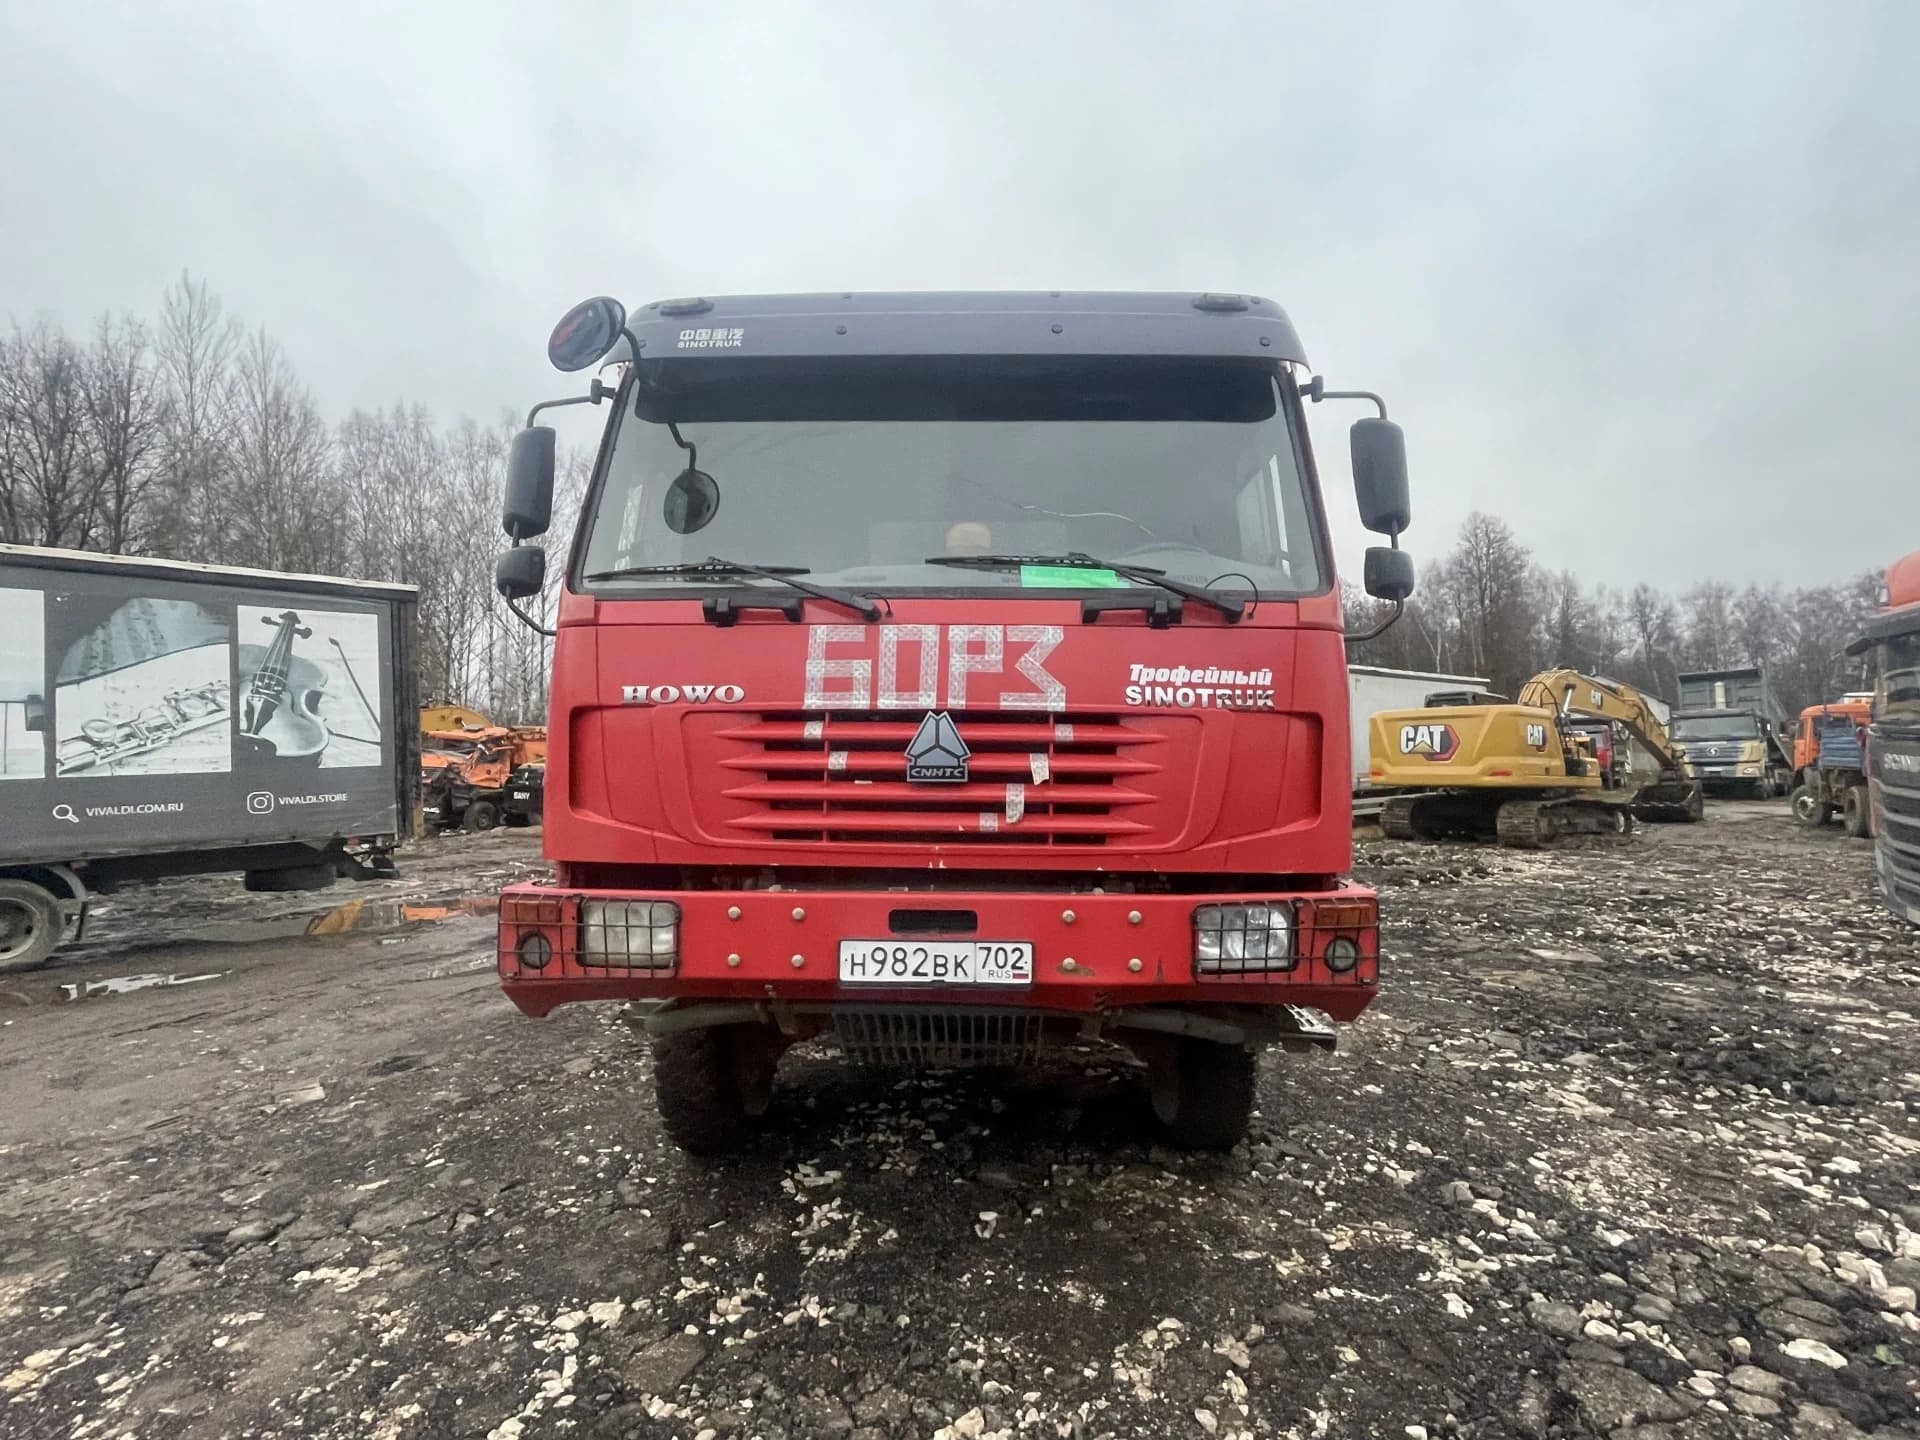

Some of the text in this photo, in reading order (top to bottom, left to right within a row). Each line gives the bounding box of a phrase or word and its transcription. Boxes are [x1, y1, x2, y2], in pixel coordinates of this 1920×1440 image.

[677, 340, 742, 349] SINOTRUK
[1129, 663, 1273, 686] Трофейный
[621, 684, 745, 704] HOWO
[1125, 686, 1275, 711] SINOTRUK
[1400, 725, 1445, 754] CAT
[1527, 723, 1544, 746] CAT
[910, 767, 964, 777] CNHTC
[86, 802, 184, 817] VIVALDI.COM.RU
[278, 793, 348, 806] VIVALDI.STORE
[978, 946, 1025, 970] 702
[988, 969, 1012, 978] RUS
